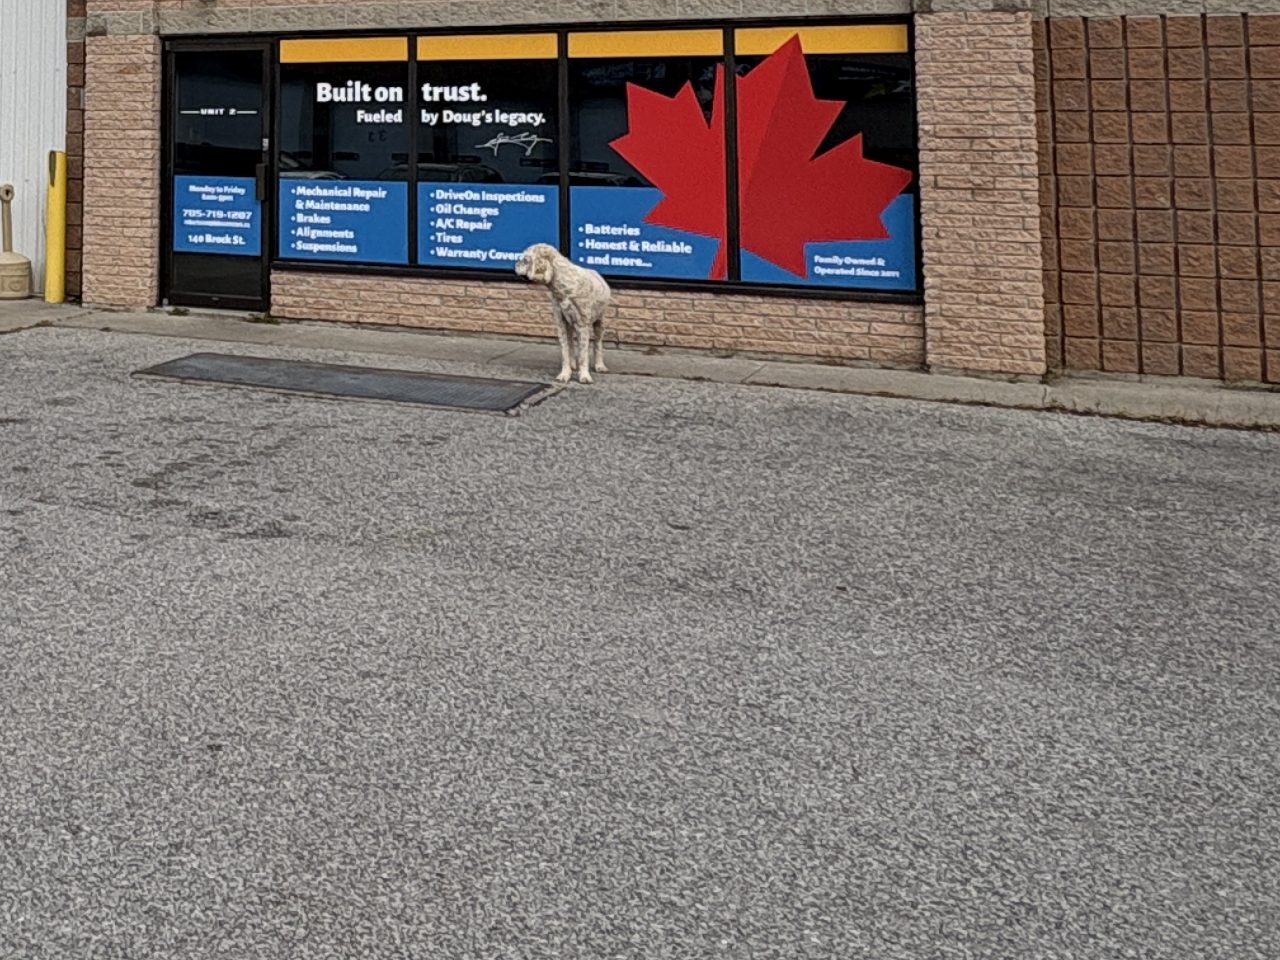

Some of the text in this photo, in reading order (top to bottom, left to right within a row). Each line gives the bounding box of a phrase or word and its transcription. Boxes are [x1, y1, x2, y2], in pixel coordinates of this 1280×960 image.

[316, 80, 488, 102] Built on trust.
[356, 109, 546, 126] Fueled by Doug's legacy.
[224, 186, 246, 195] Friday
[296, 186, 387, 200] Mechanical Repair
[435, 189, 545, 204] DriveOn Inspections
[295, 200, 370, 212] & Maintenance
[435, 204, 500, 218] Oil Changes
[296, 213, 331, 224] Brakes
[435, 218, 493, 231] A/C Repair
[296, 226, 354, 239] Alignments
[585, 224, 641, 236] Batteries
[188, 234, 204, 244] 140
[233, 235, 246, 245] St.
[435, 232, 463, 243] Tires
[296, 240, 358, 253] Suspensions
[585, 239, 693, 253] Honest & Reliable
[435, 247, 487, 261] Warranty
[586, 254, 610, 265] and
[814, 255, 843, 265] Family
[844, 256, 876, 266] Owned
[814, 266, 855, 276] Operated
[856, 267, 879, 277] Since
